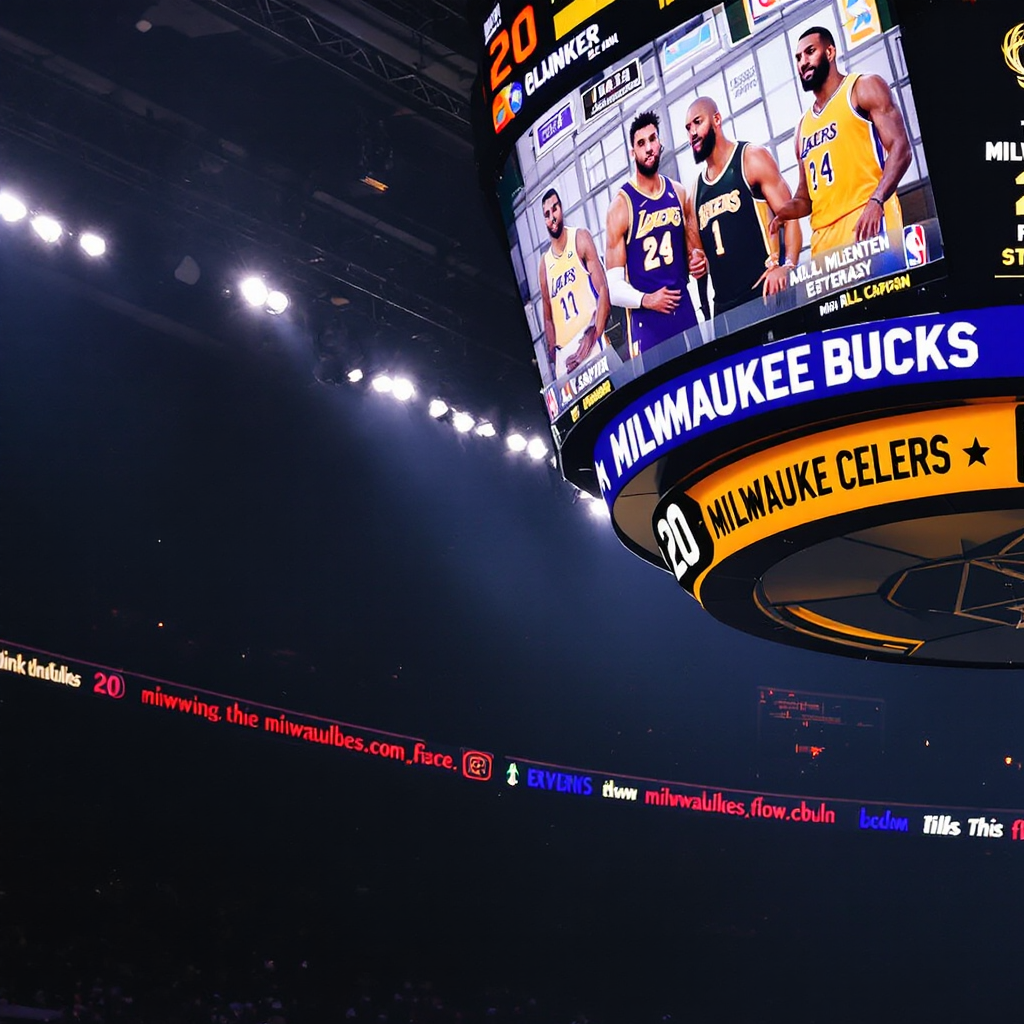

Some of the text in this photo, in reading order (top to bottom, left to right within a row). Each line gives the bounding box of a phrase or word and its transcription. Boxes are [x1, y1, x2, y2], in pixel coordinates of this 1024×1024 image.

[490, 5, 538, 91] 20
[642, 231, 674, 272] 24
[822, 322, 979, 386] BUCKS
[657, 503, 700, 581] 20
[707, 455, 833, 540] MILWAUKE
[836, 433, 951, 487] CELERS
[967, 816, 1004, 838] This
